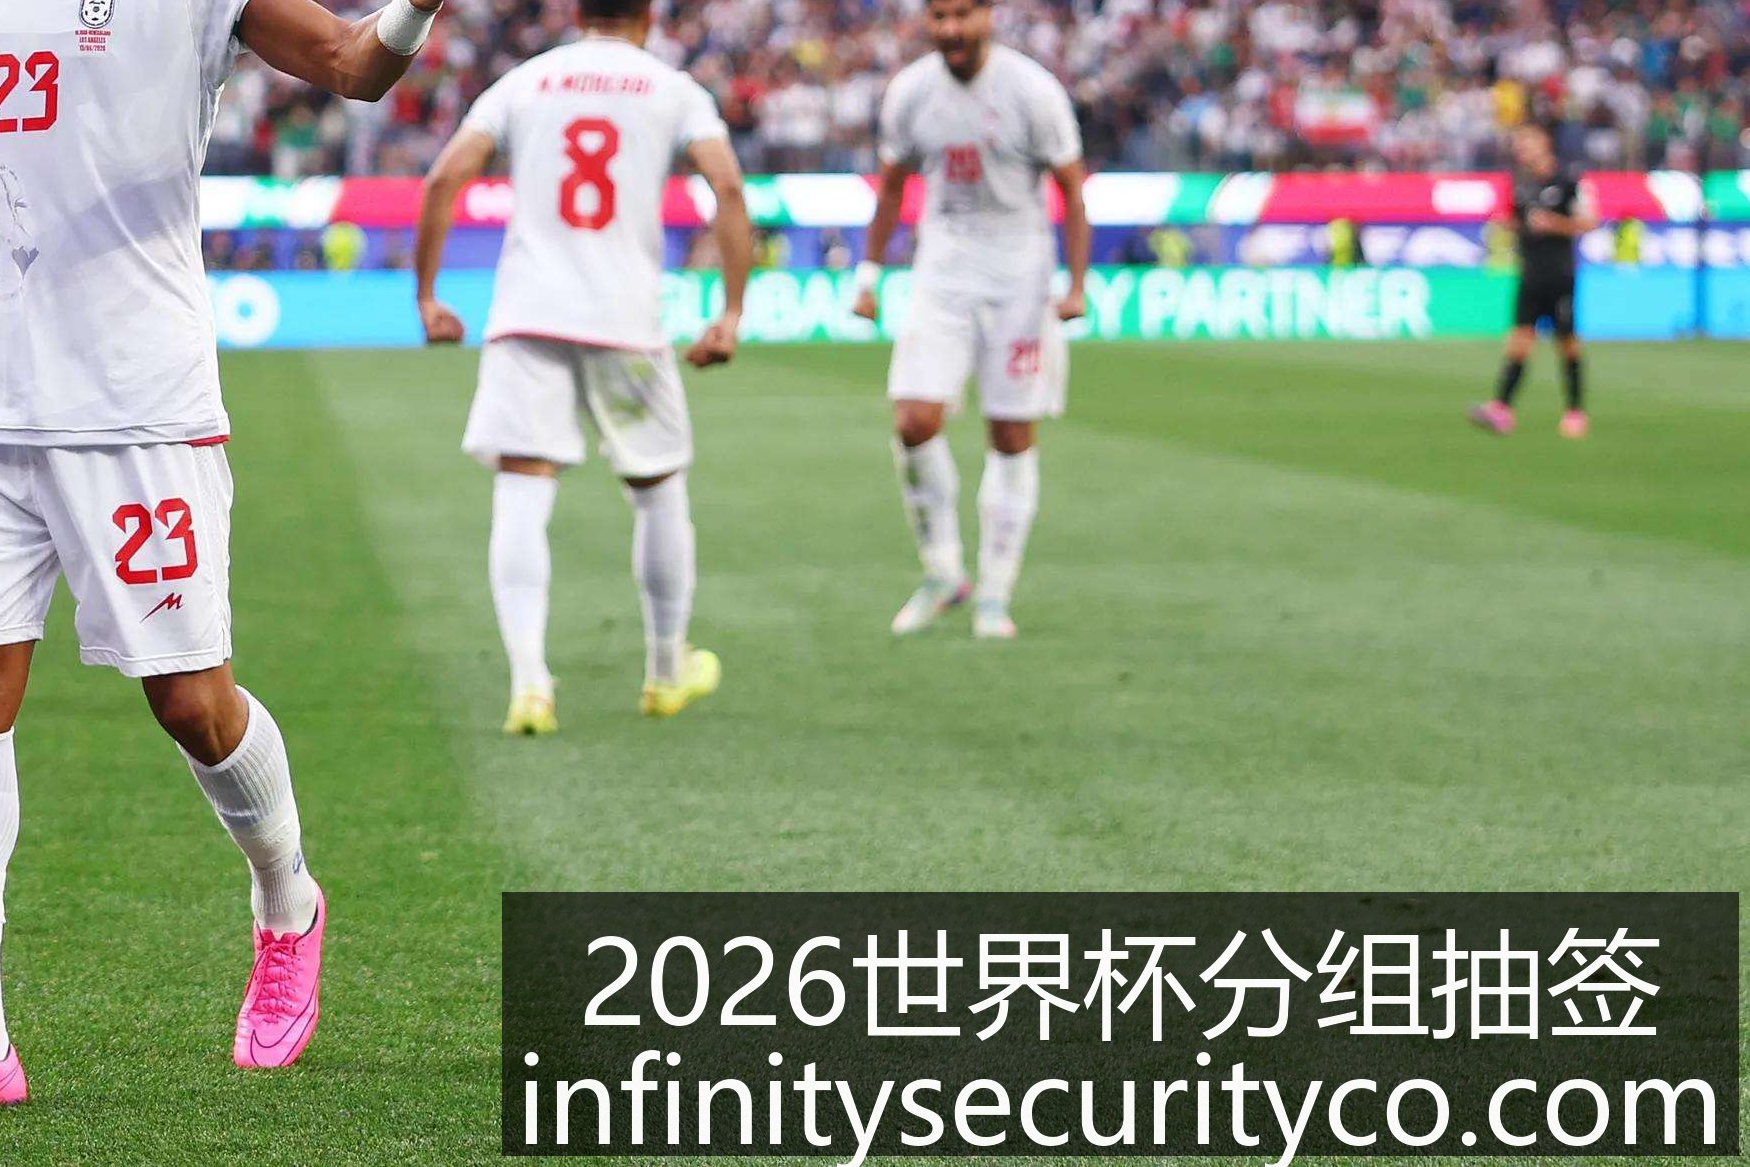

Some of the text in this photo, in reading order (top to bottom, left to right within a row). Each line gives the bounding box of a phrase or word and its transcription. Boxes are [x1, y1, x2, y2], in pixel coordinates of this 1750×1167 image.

[560, 118, 619, 231] 8
[1138, 267, 1433, 340] PARTNER
[112, 498, 198, 585] 23
